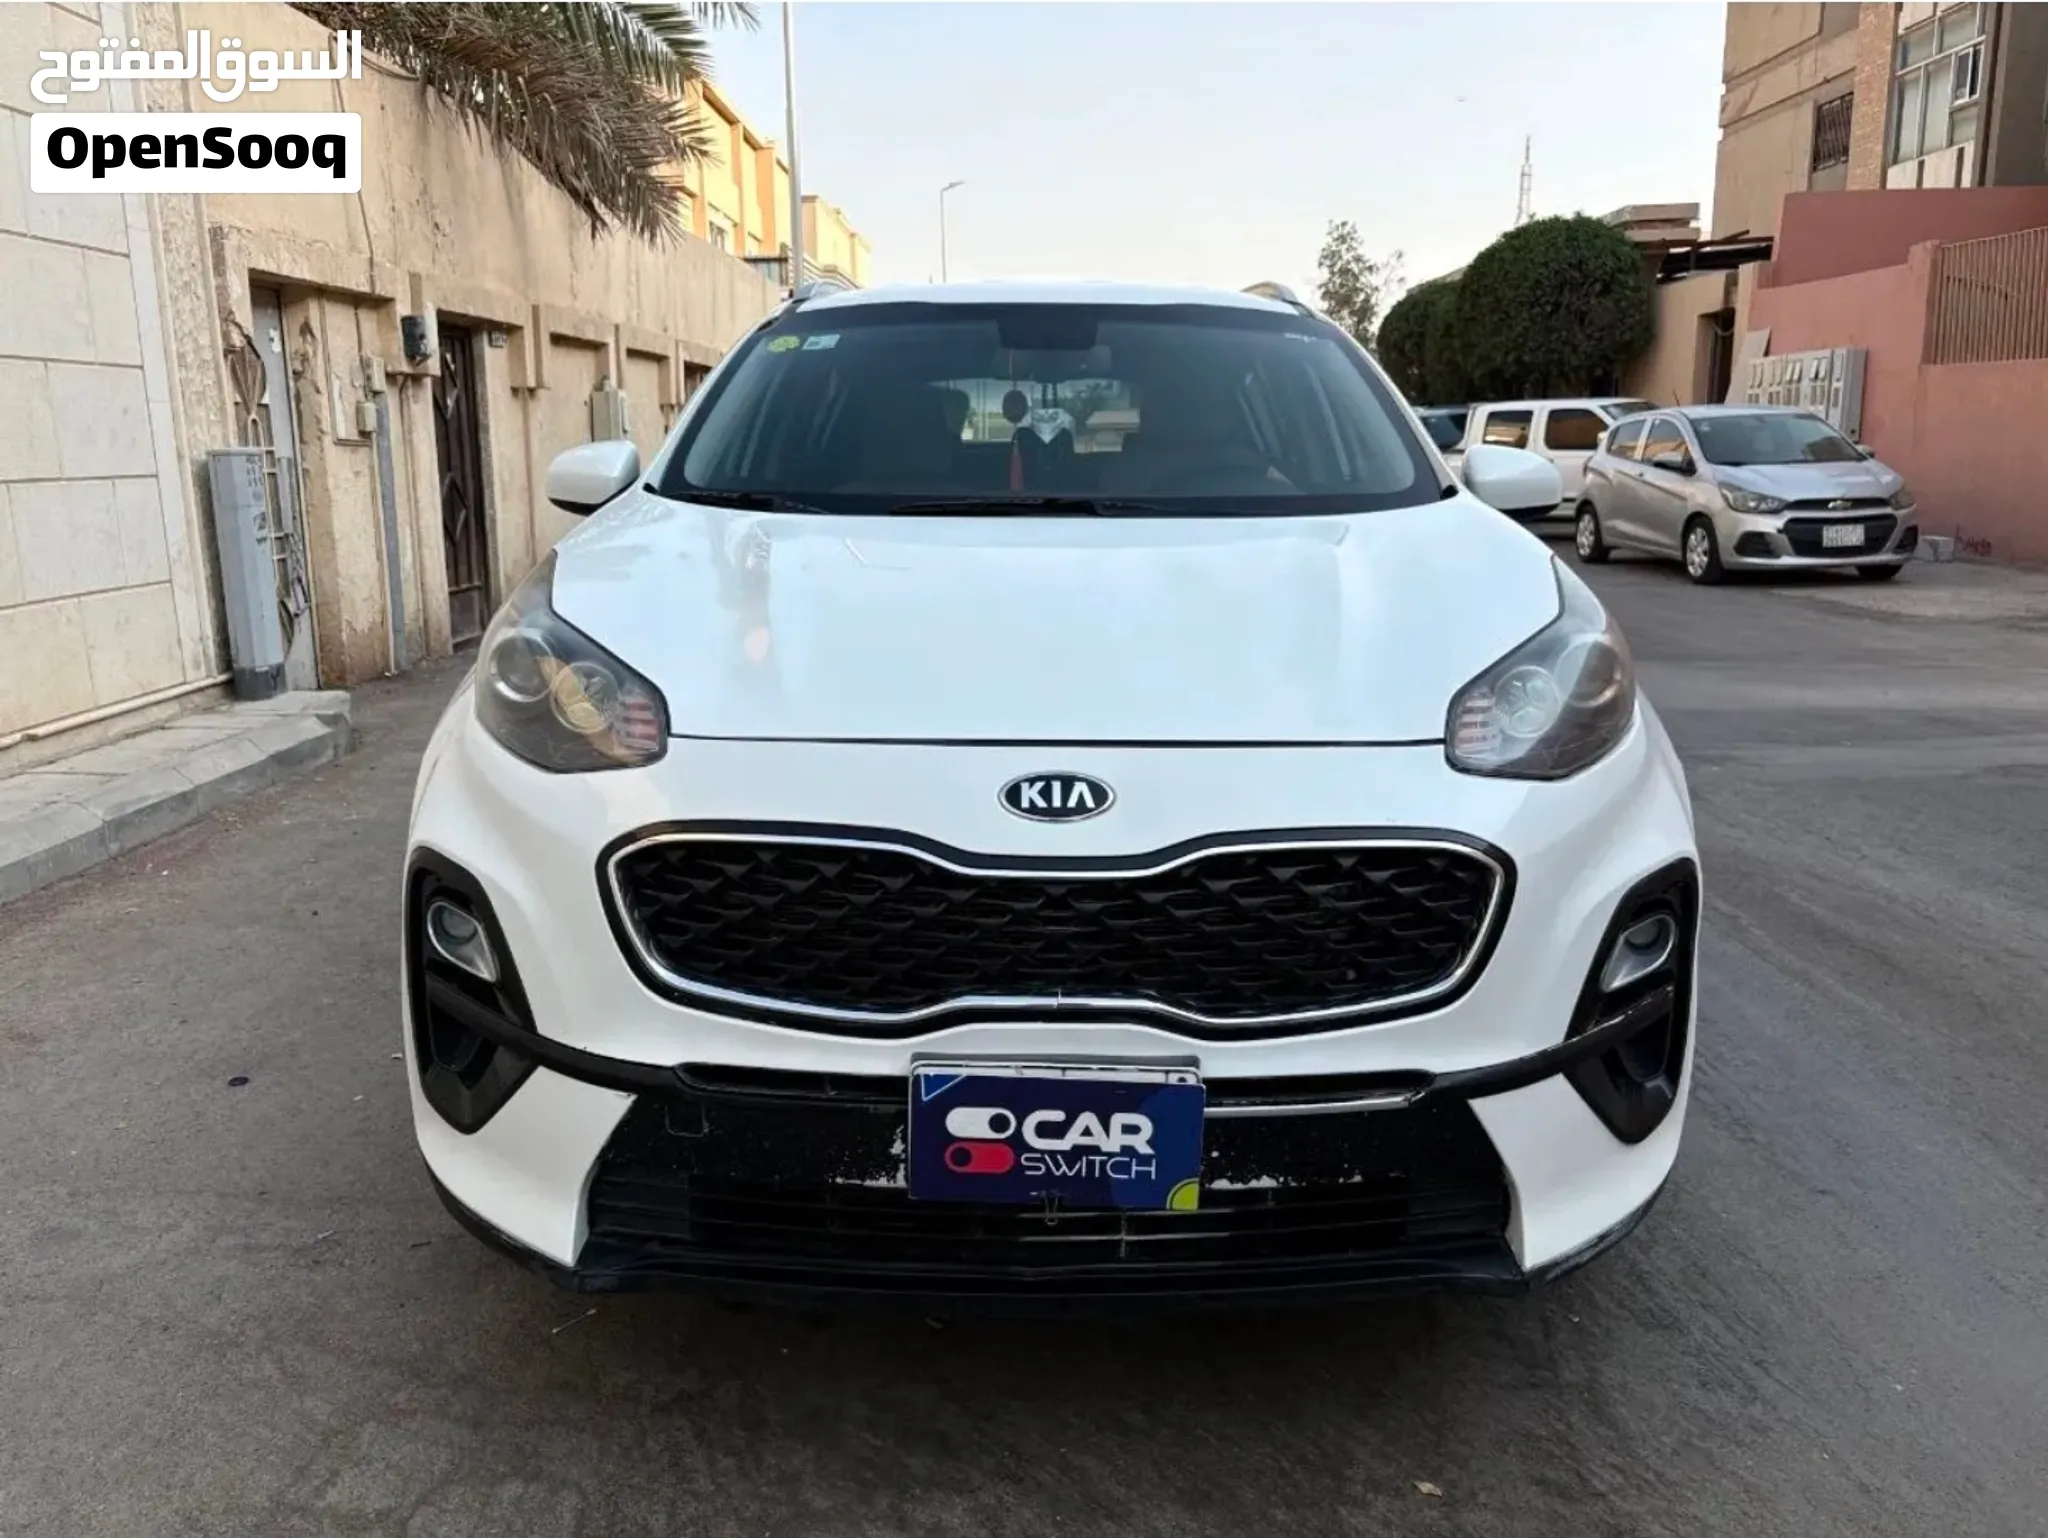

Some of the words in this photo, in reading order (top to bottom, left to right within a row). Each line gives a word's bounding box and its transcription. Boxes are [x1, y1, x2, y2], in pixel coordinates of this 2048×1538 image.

[1020, 780, 1096, 809] KIA
[1022, 1109, 1155, 1154] CAR
[1021, 1153, 1156, 1180] SWITCH
